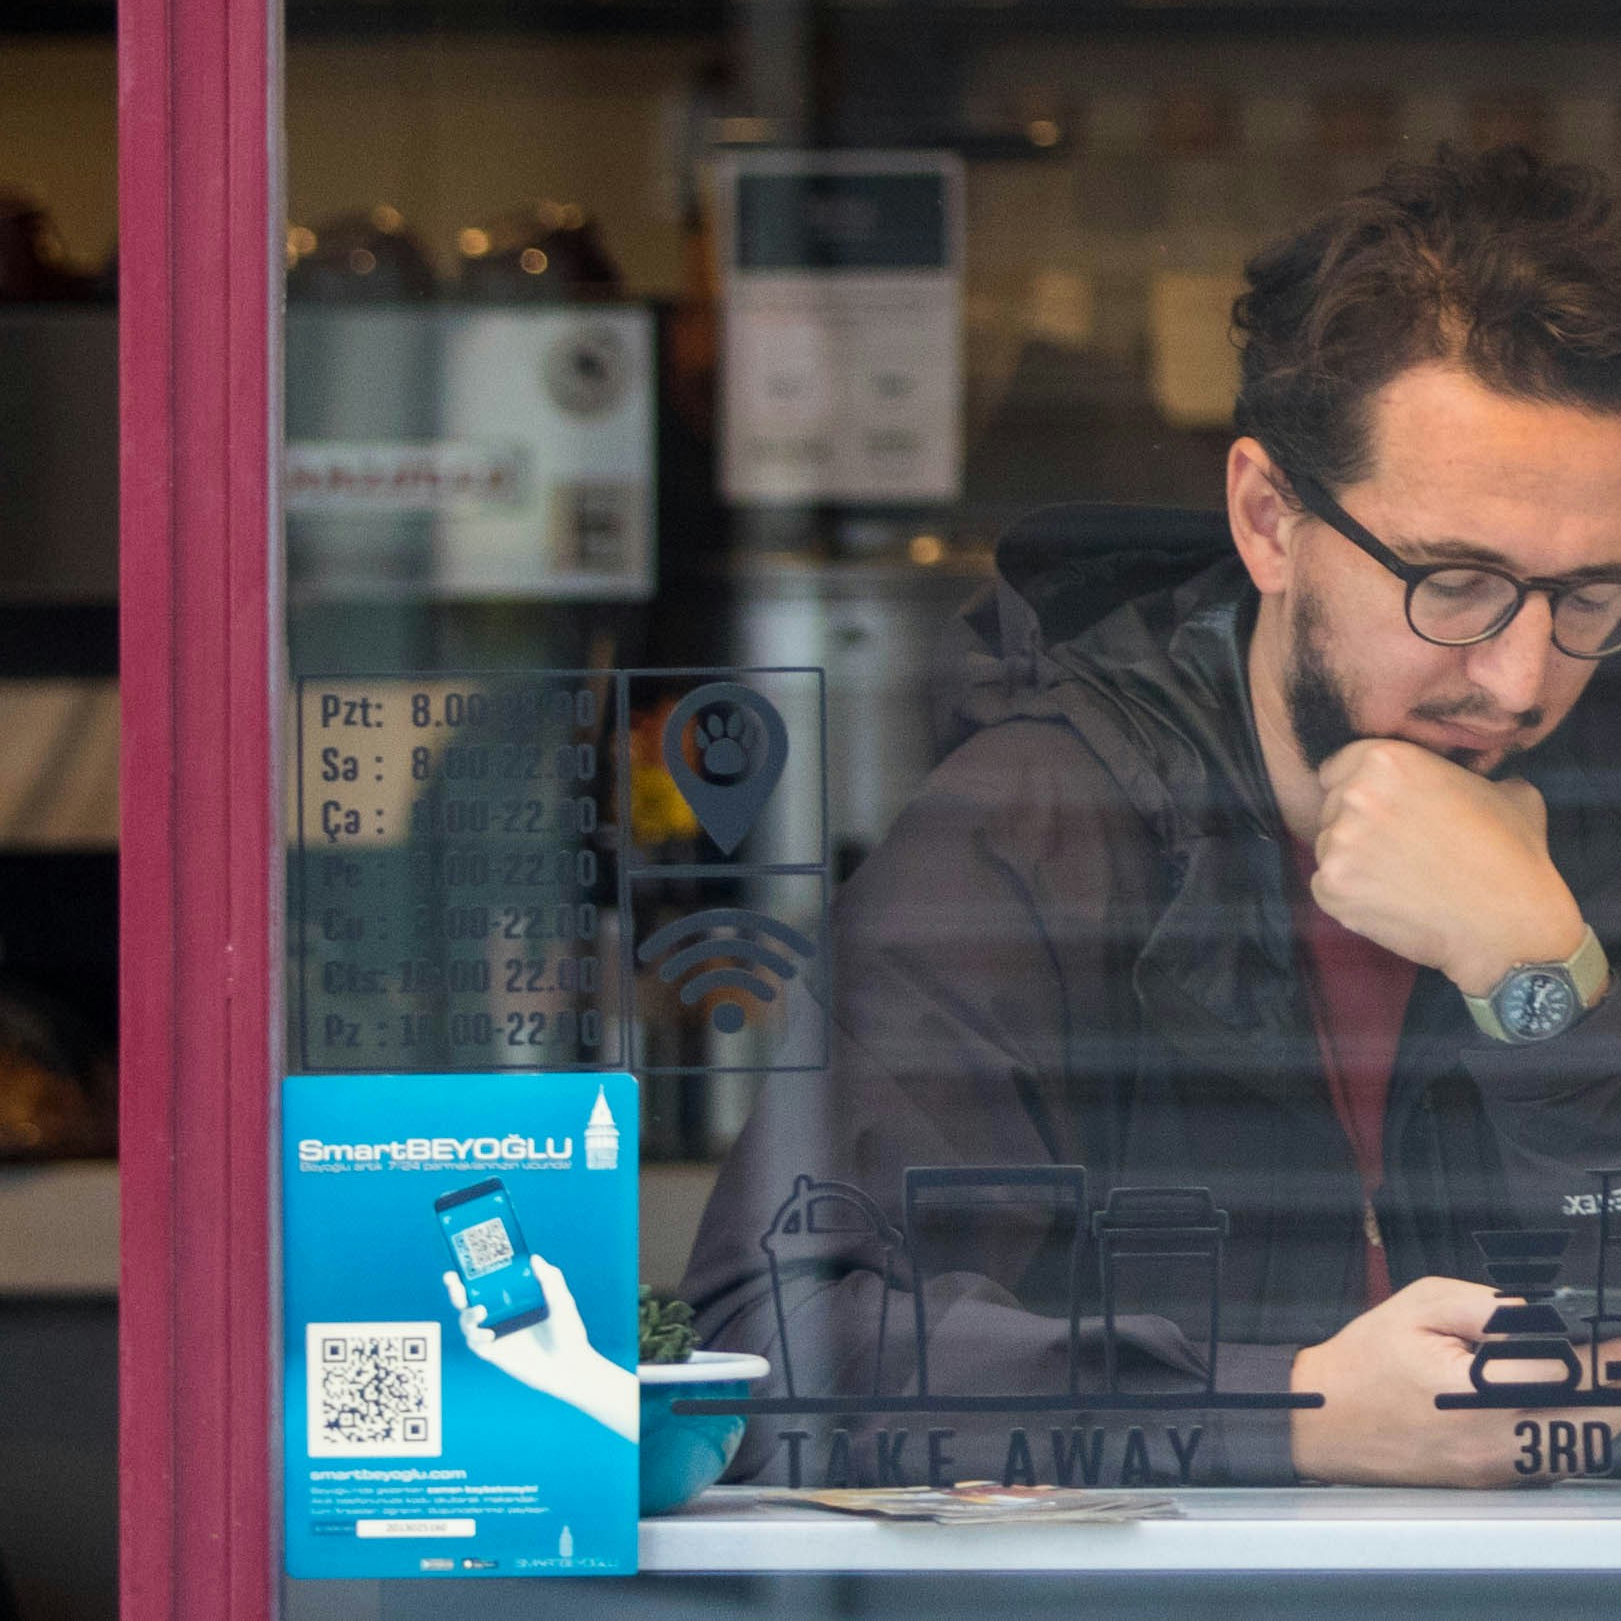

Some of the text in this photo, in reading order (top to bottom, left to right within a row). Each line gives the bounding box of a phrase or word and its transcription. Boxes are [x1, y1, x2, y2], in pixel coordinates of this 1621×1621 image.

[321, 693, 384, 728] Pzt:
[299, 1133, 573, 1161] SmartBEYOĞLU
[777, 1425, 1204, 1489] TAKE AWAY
[1513, 1420, 1614, 1476] 3RD
